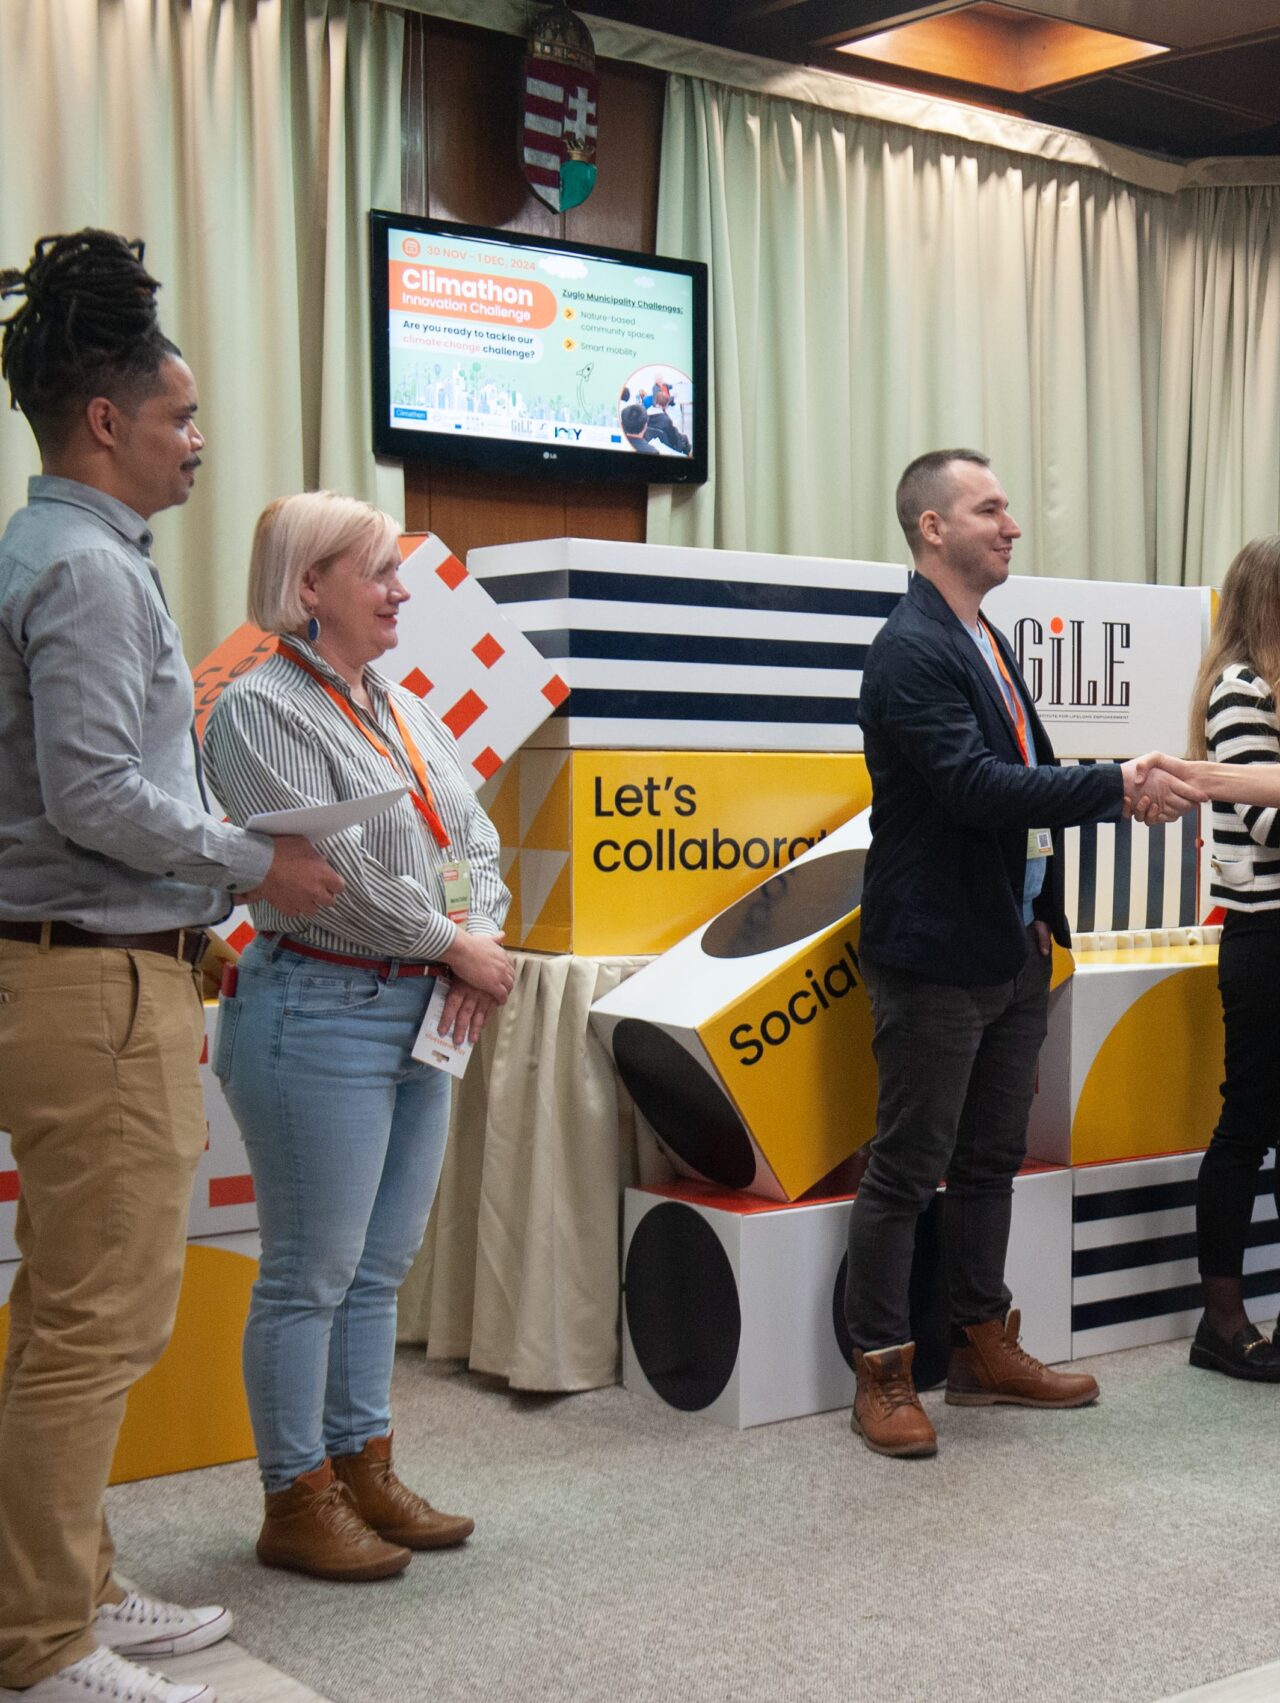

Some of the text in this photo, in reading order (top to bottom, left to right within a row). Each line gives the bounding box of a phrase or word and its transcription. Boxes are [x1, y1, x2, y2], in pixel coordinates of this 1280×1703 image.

[427, 245, 440, 255] 30
[443, 248, 467, 260] NOV
[511, 258, 536, 271] 2024
[402, 268, 534, 307] Climathon
[402, 293, 531, 323] Innovation Challenge
[586, 293, 637, 308] Municipality
[638, 300, 684, 315] Challenges:
[581, 311, 636, 325] Nature-based
[403, 320, 534, 345] Are you ready to tackle our
[580, 324, 655, 340] community spaces
[403, 335, 535, 360] climate change challenge?
[580, 342, 637, 358] Smart mobility
[593, 828, 827, 872] collabora
